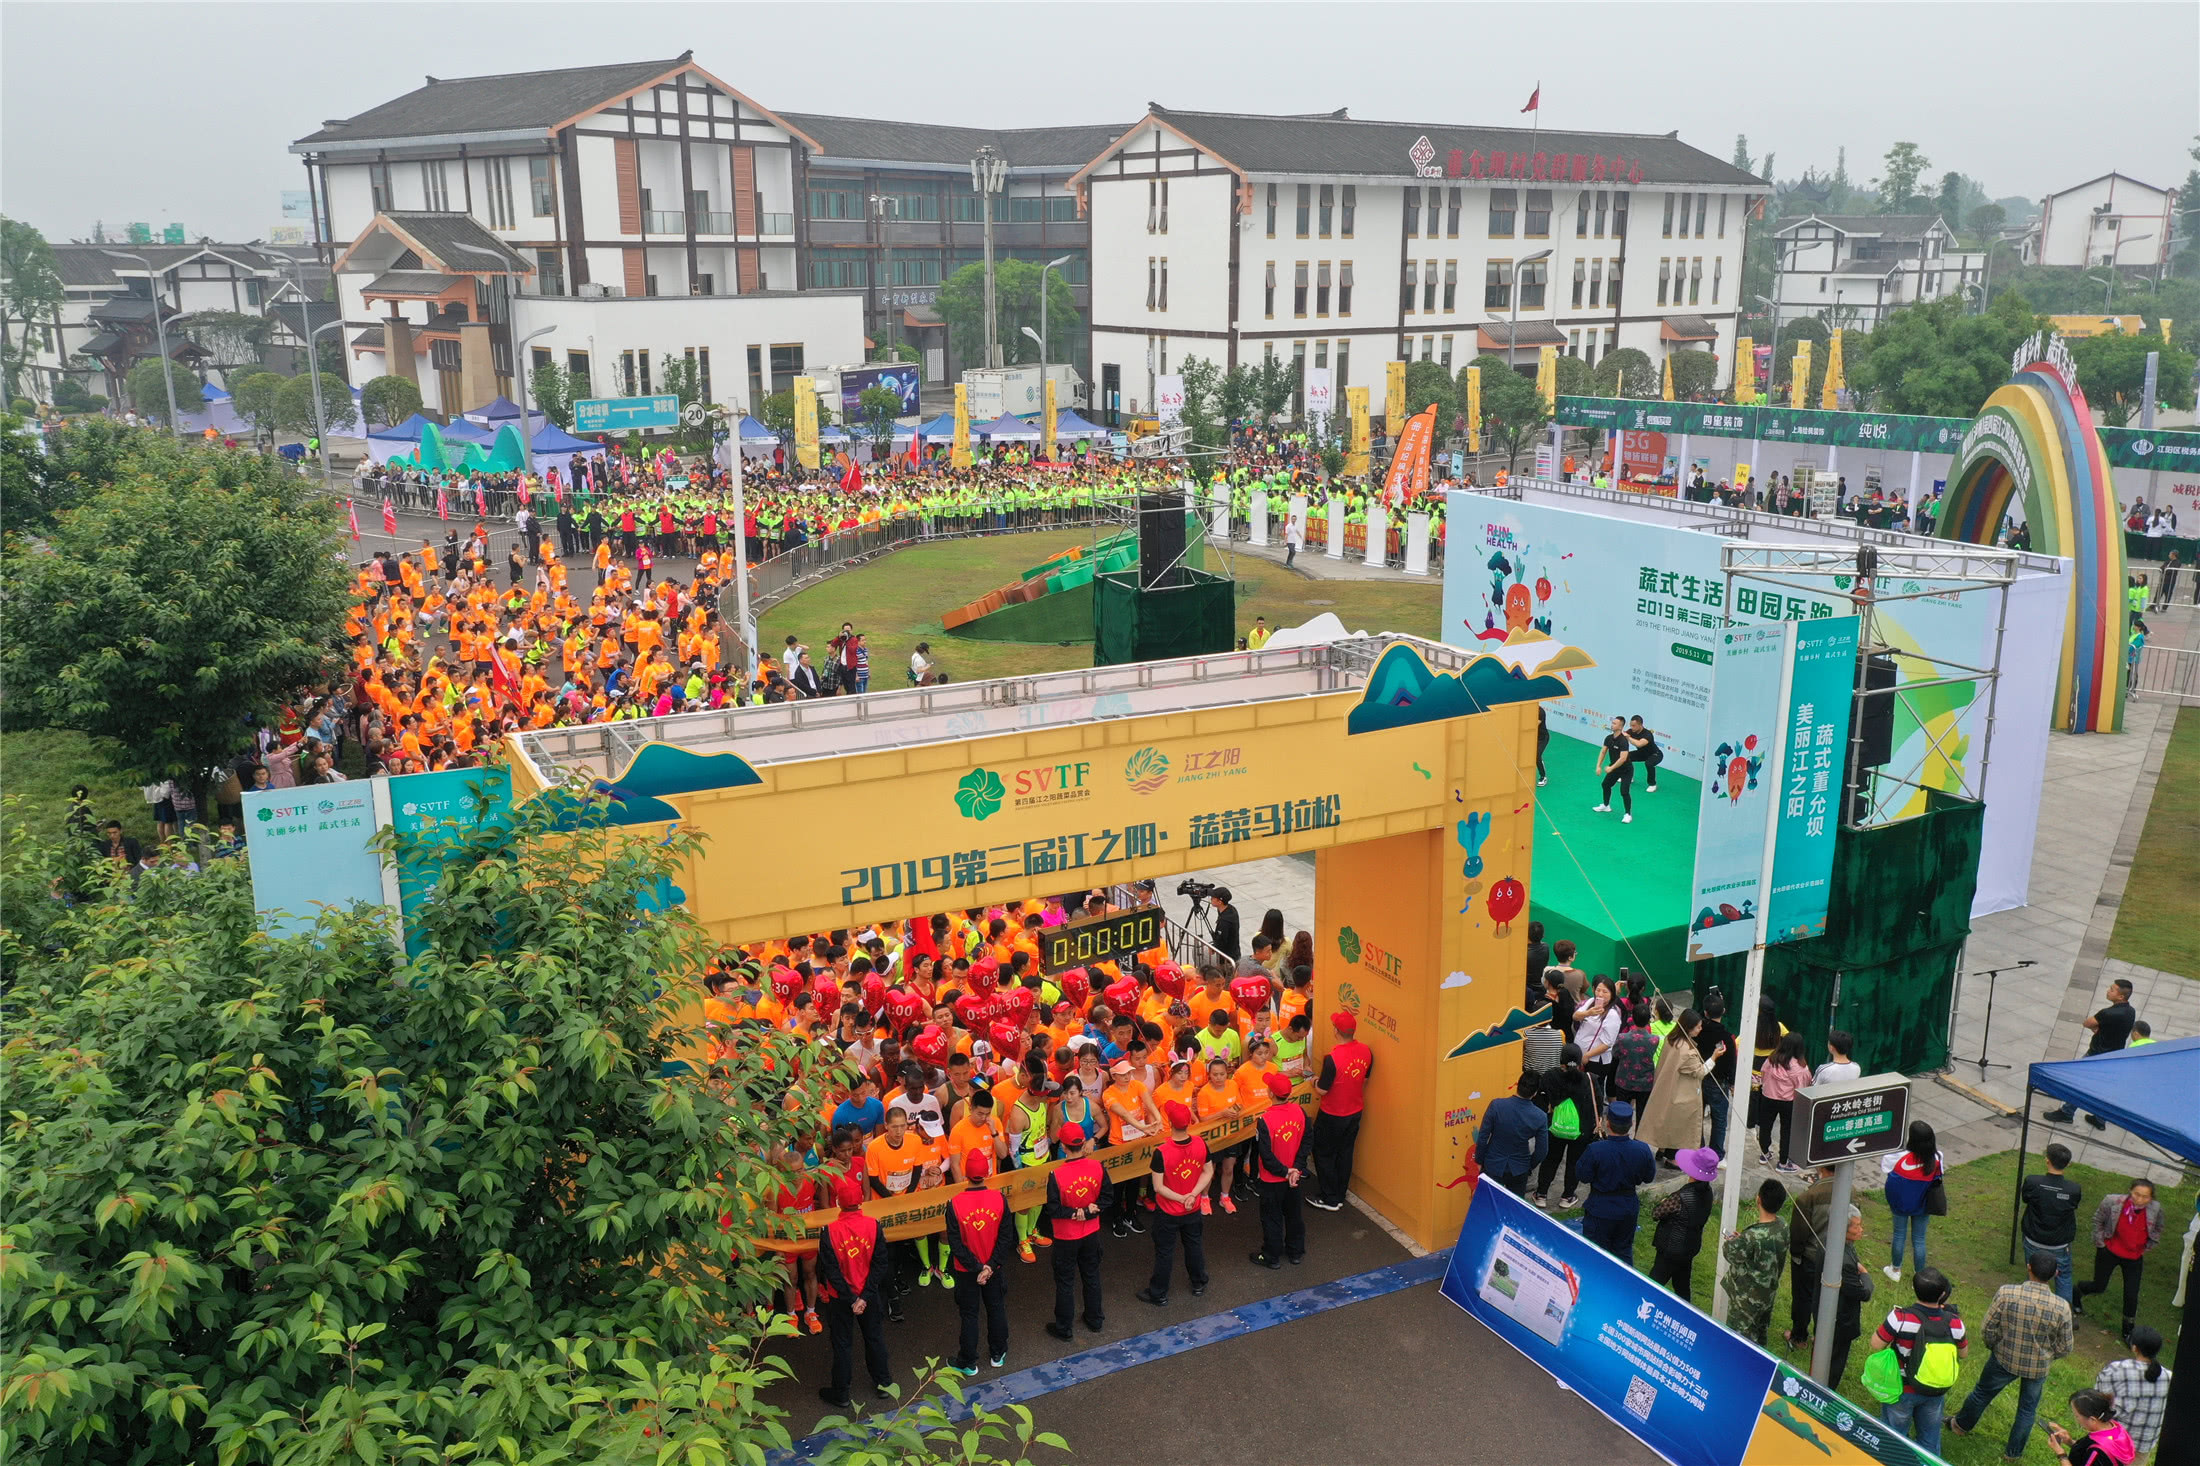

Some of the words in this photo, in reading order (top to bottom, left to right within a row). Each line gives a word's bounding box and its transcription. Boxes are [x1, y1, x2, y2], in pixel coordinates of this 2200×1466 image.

[1447, 149, 1644, 184] 董允坝村党群服务中心
[688, 410, 703, 420] 20
[1703, 415, 1744, 427] 四星装饰
[1625, 432, 1650, 449] 5G
[1859, 423, 1888, 439] 纯悦
[2157, 446, 2200, 456] 江阳区税务
[1486, 537, 1518, 551] HEALTH
[1639, 566, 1724, 607] 蔬式生活
[1737, 587, 1833, 620] 田园乐跑
[1637, 598, 1674, 619] 2019
[1636, 619, 1648, 628] 2019
[1650, 622, 1661, 631] THE
[1662, 625, 1680, 636] THIRD
[1681, 629, 1699, 640] JIANG
[1734, 632, 1752, 642] SVTF
[1806, 638, 1824, 648] SVTF
[1183, 747, 1241, 773] 江之阳
[1786, 702, 1814, 819] 美丽江之阳
[1015, 762, 1091, 796] SVTF
[1177, 772, 1203, 783] JIANG
[1205, 770, 1221, 780] ZHI
[1223, 766, 1248, 777] YANG
[1806, 723, 1835, 838] 蔬式董允坝
[419, 800, 450, 813] SVTF
[1014, 789, 1091, 807] 第四届江之阳蔬菜品赏会
[275, 804, 309, 819] SVTF
[265, 823, 307, 837] 美丽乡村
[318, 817, 361, 830] 蔬式生活
[1189, 794, 1341, 850] 蔬菜马拉松
[1053, 916, 1153, 967] 0:00:00
[1365, 942, 1403, 976] SVTF
[1116, 985, 1140, 1008] 1:15
[1236, 985, 1266, 998] 1:15
[886, 1004, 912, 1016] 1:00
[1367, 1003, 1397, 1033] 江之阳
[927, 1031, 947, 1055] 1:00
[1831, 1095, 1883, 1114] 分水岭老街
[1445, 1114, 1476, 1128] HEALTH
[1654, 1308, 1698, 1343] 泸州新闻网
[1801, 1388, 1829, 1410] SVTF
[1857, 1426, 1880, 1446] 江之阳
